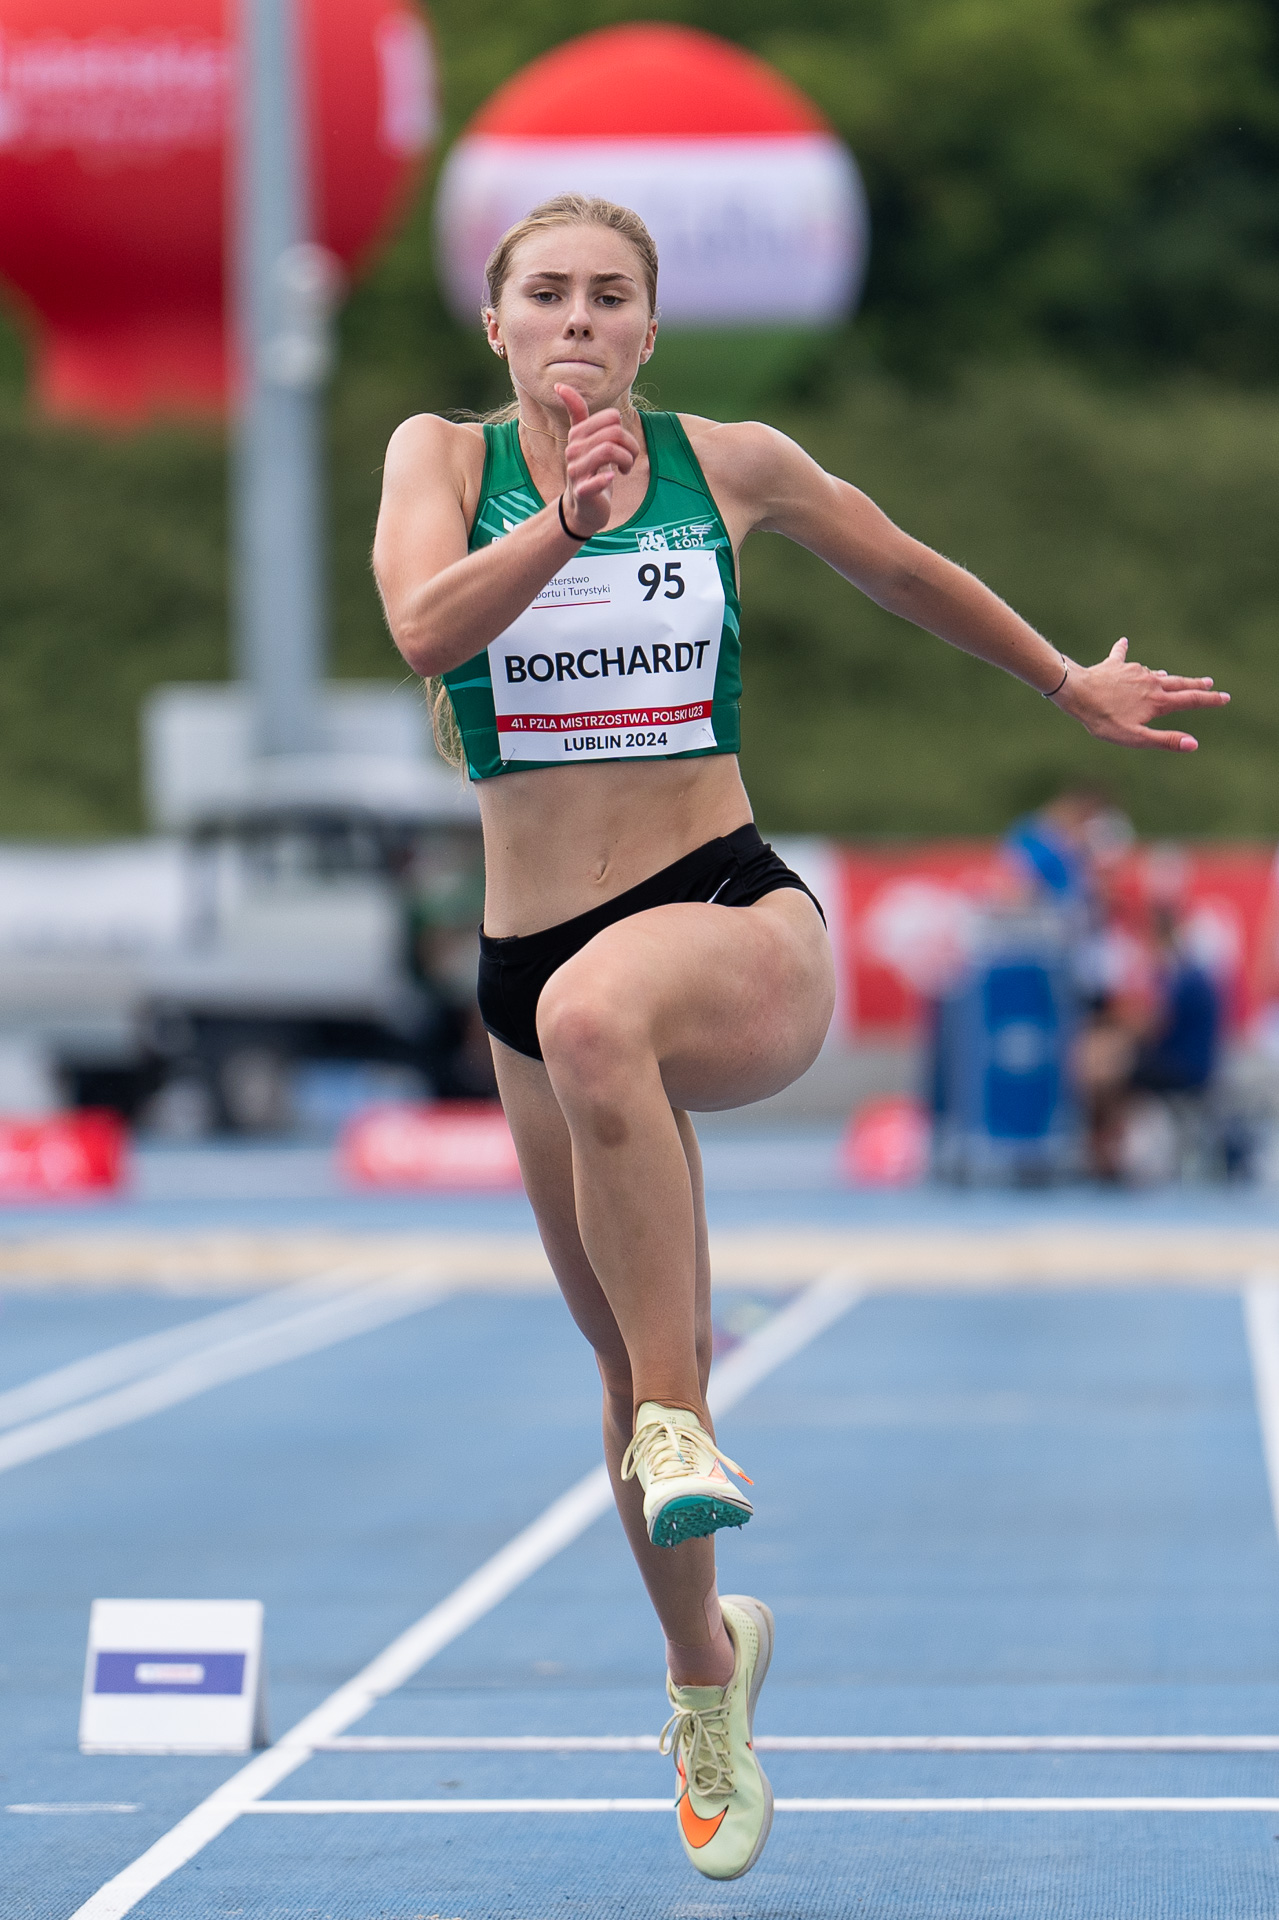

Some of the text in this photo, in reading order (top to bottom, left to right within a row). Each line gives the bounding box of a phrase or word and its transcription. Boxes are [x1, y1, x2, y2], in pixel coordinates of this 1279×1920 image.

[672, 524, 713, 538] AZS
[546, 576, 590, 587] sterstwo
[637, 562, 685, 601] 95
[535, 584, 611, 600] portu i Turystyki
[505, 640, 711, 683] BORCHARDT
[511, 705, 704, 729] 41. PZLA MISTRZOSTWA POLSKI U23
[564, 732, 668, 752] LUBLIN 2024
